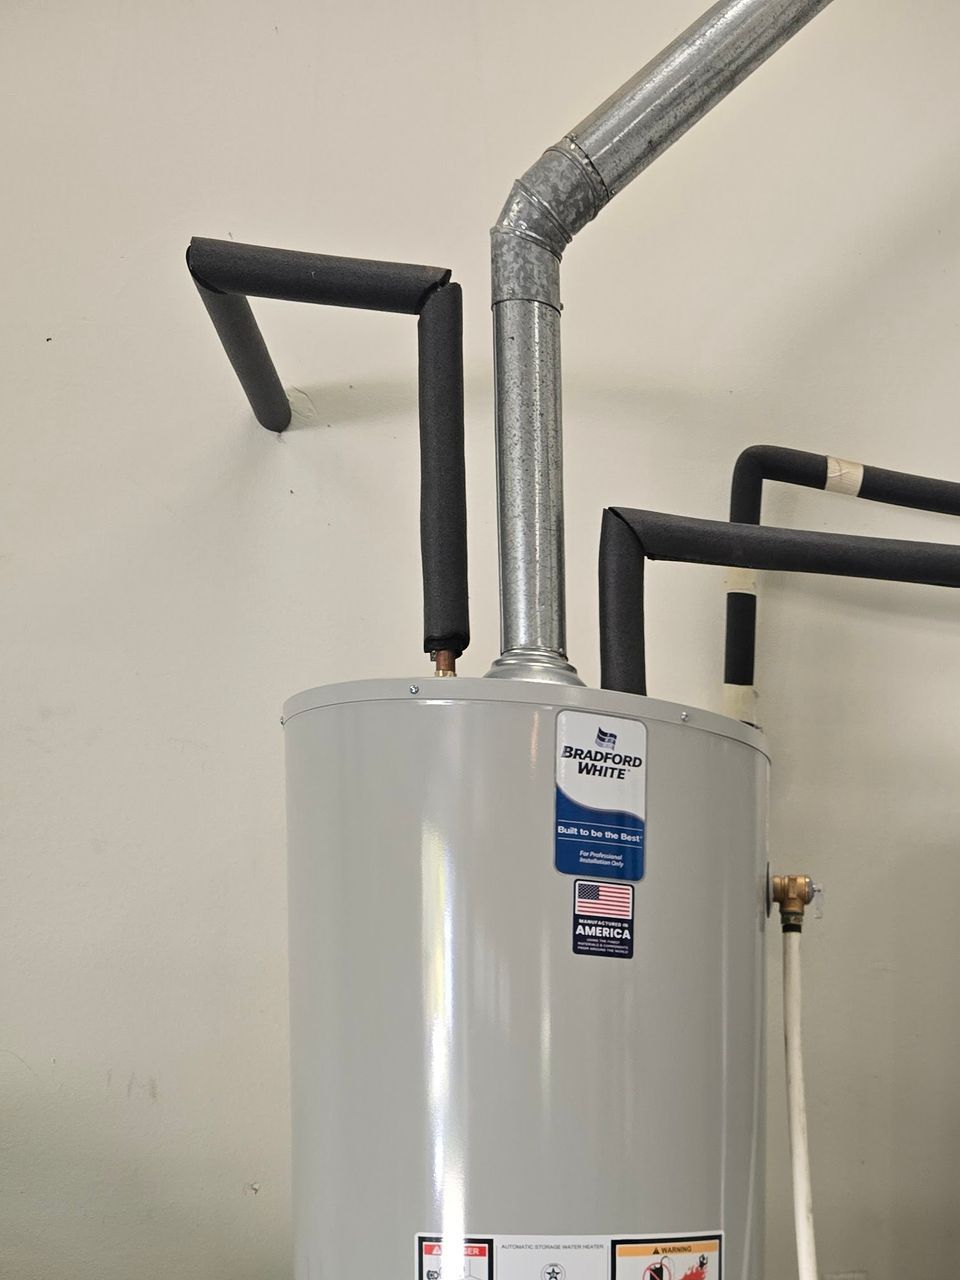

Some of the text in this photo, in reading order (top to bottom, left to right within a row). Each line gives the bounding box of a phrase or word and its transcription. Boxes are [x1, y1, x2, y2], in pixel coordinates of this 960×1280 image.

[561, 745, 643, 768] BRADFORD
[578, 761, 626, 780] WHITE
[557, 825, 640, 842] Built to be the Best
[590, 851, 623, 860] Professional
[611, 860, 624, 868] Only
[579, 919, 622, 927] MANUFACTURED
[575, 925, 631, 940] AMERICA
[661, 1246, 692, 1254] WARNING
